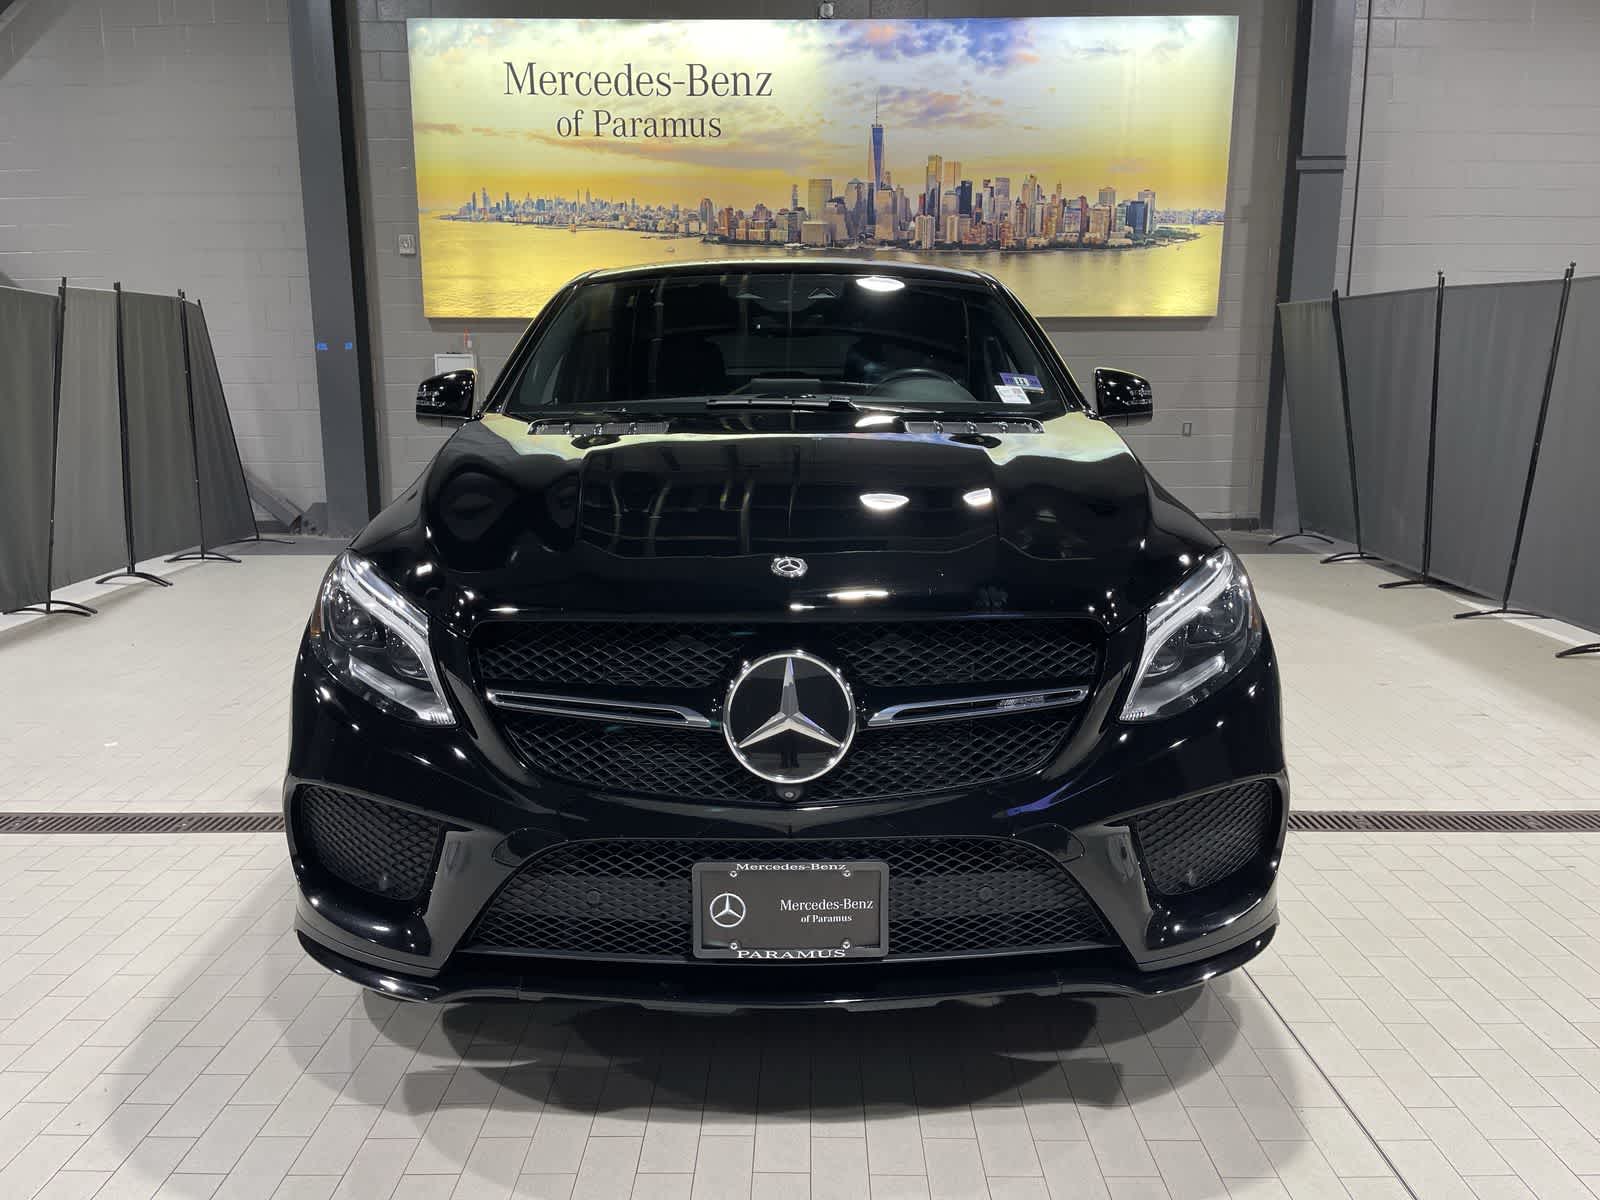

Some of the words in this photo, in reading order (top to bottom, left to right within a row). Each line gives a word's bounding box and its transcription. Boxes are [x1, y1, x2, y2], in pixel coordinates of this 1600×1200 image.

[503, 62, 773, 97] Mercedes-Benz
[556, 109, 584, 138] of
[594, 109, 722, 138] Paramus
[736, 863, 848, 871] Mercedes-Benz
[780, 898, 874, 911] Mercedes-Benz
[801, 914, 811, 923] of
[812, 914, 852, 923] Paramus
[736, 949, 846, 959] PARAMUS
